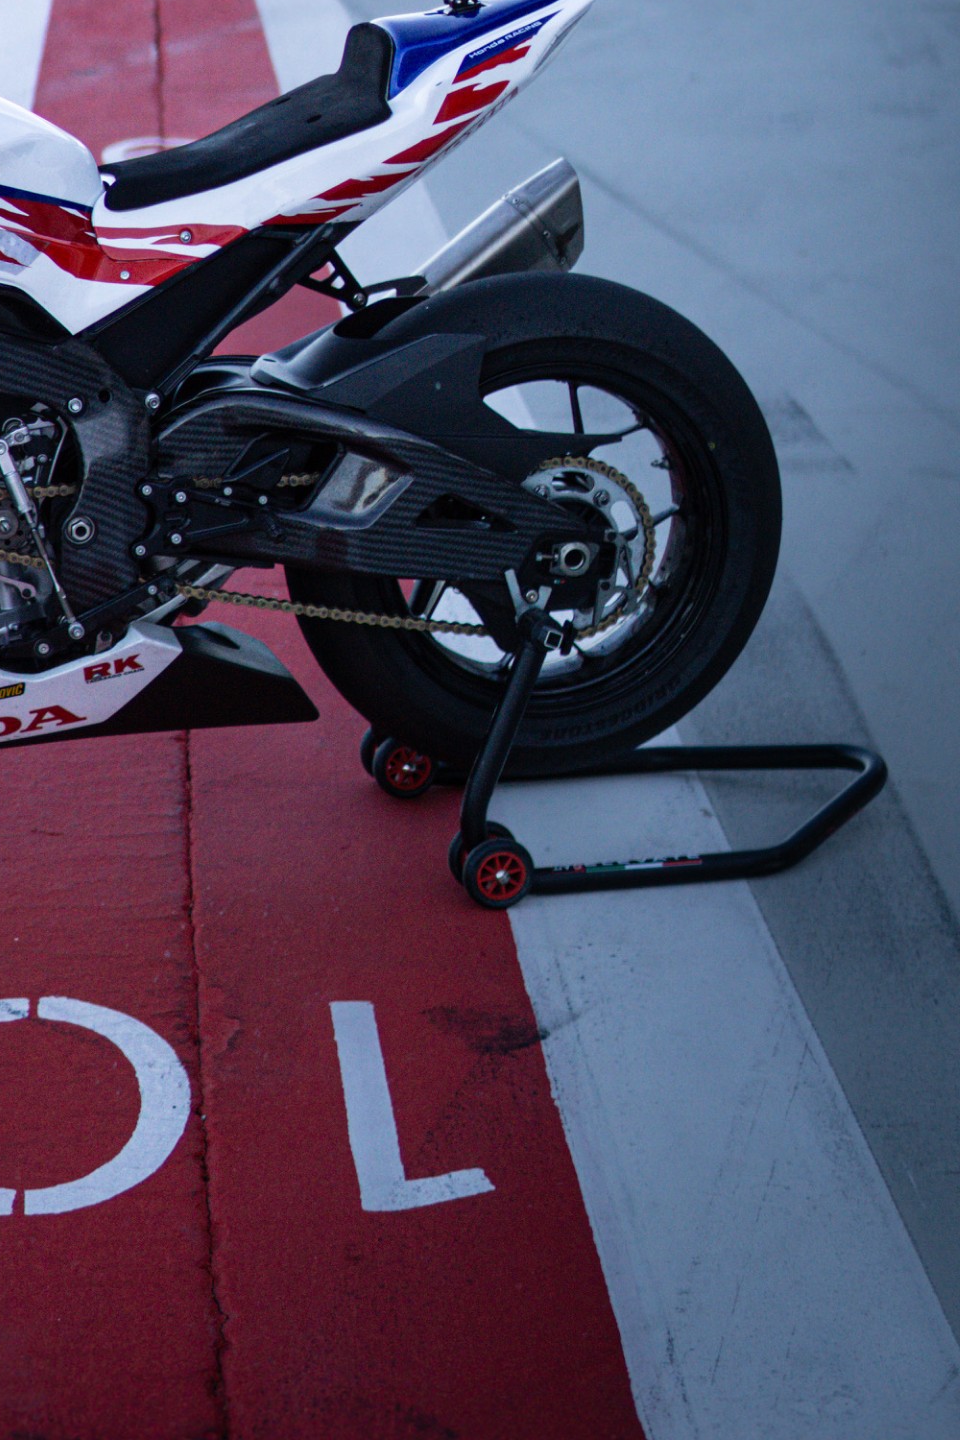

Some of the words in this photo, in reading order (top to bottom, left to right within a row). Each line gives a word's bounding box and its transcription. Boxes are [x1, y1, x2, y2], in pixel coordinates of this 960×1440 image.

[468, 38, 505, 59] Honda
[504, 20, 543, 41] RACING
[83, 653, 143, 683] RK
